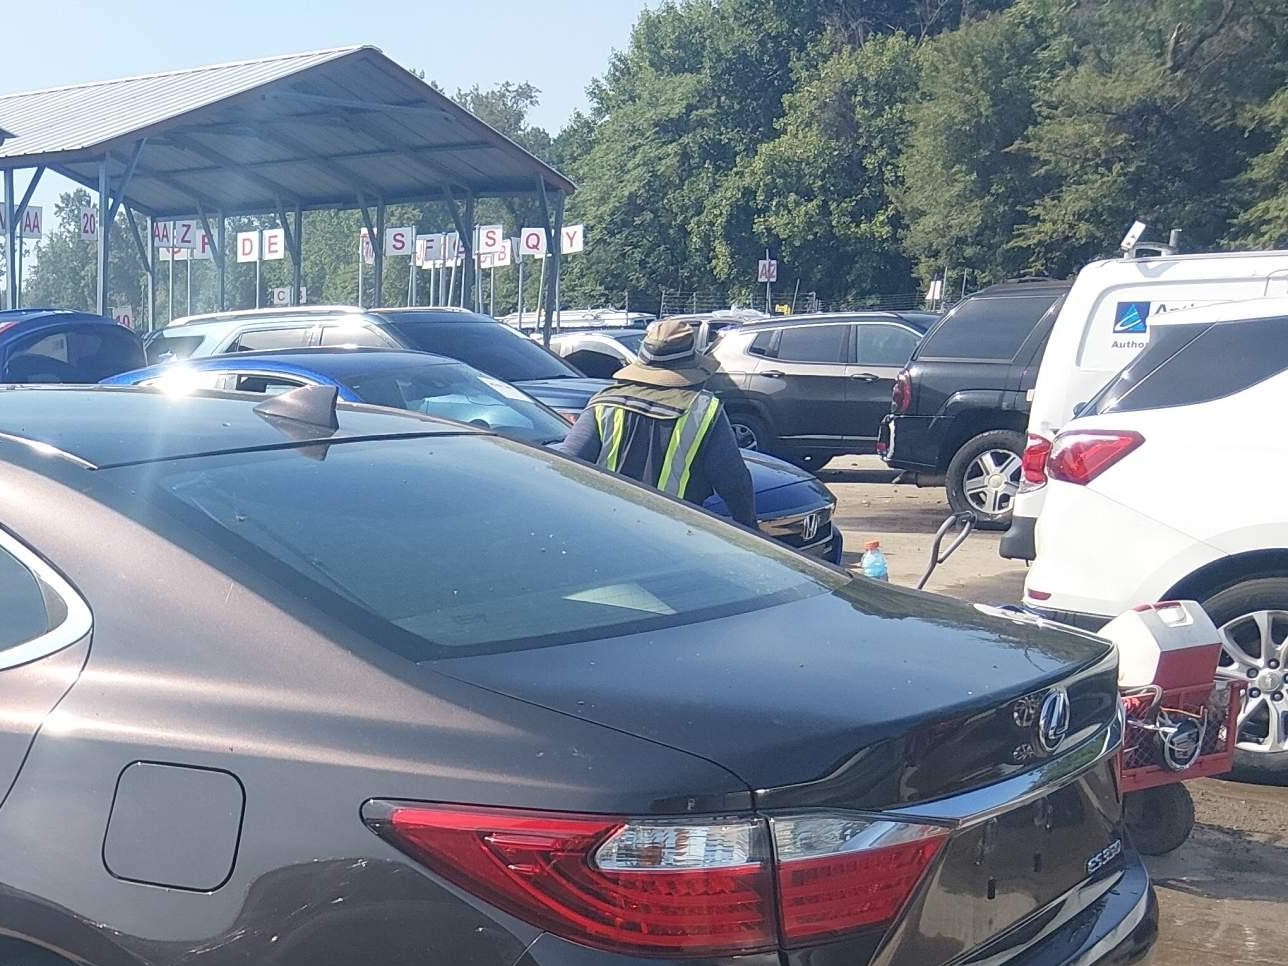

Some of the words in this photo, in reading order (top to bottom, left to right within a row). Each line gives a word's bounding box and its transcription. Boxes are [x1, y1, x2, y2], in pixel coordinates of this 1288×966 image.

[23, 211, 41, 234] AA
[82, 213, 96, 235] 20
[180, 223, 192, 244] Z
[391, 232, 406, 251] S
[484, 230, 497, 248] S
[525, 232, 540, 251] Q
[565, 230, 578, 248] Y
[241, 238, 254, 257] D
[267, 234, 279, 255] E
[277, 290, 286, 302] C
